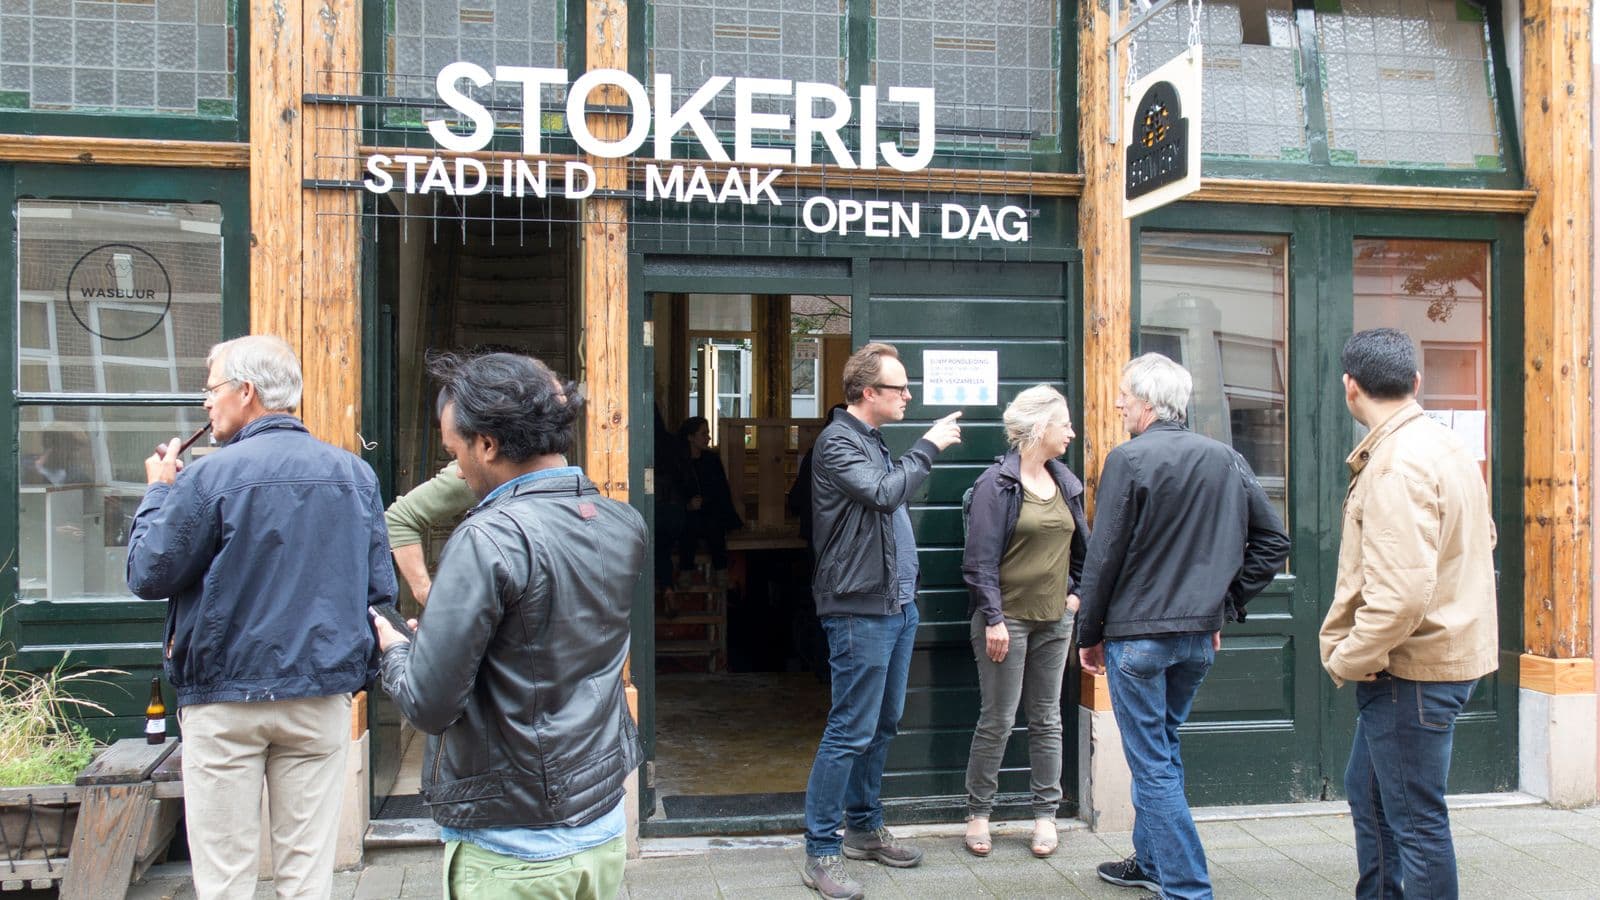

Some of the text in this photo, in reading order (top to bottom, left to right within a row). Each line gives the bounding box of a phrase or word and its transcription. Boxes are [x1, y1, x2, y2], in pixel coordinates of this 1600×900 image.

[427, 61, 936, 172] STOKERIJ
[363, 154, 783, 206] STAD IN D MAAK
[802, 195, 1029, 242] OPEN DAG
[80, 287, 156, 300] WASBUUR
